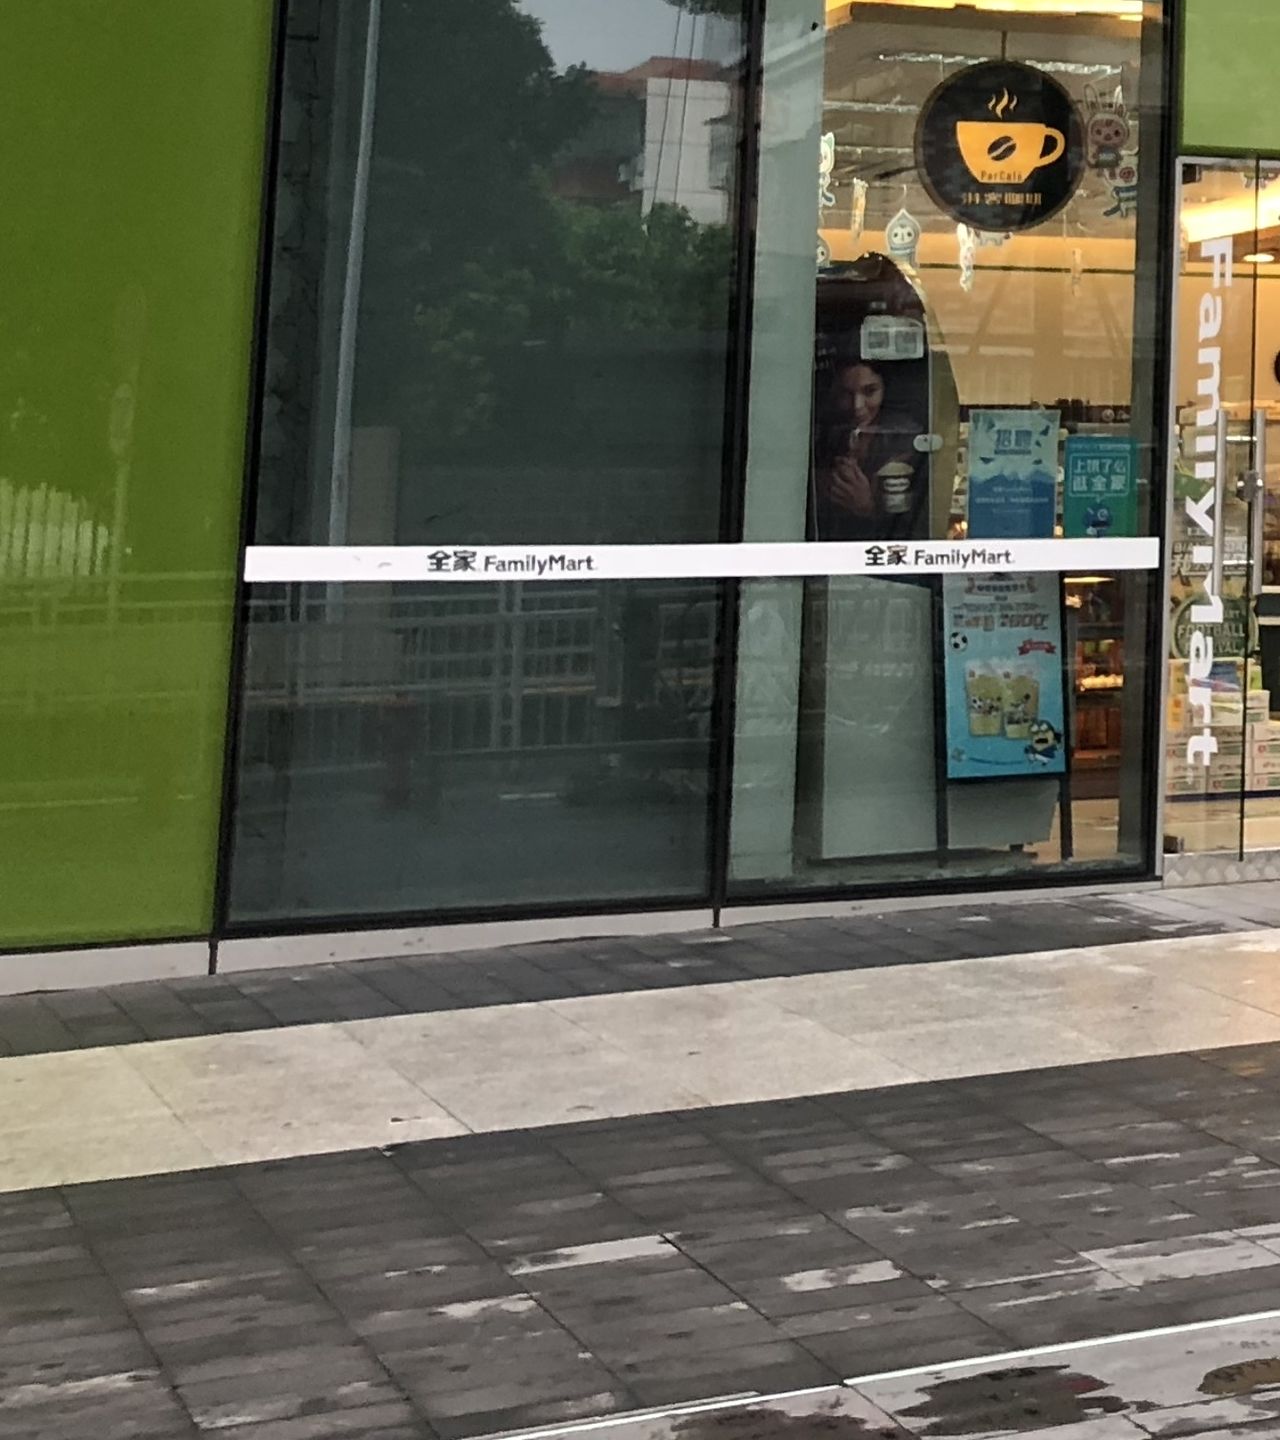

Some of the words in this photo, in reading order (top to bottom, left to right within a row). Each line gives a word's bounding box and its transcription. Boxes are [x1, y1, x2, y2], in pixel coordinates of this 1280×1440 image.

[427, 550, 477, 573] 全家
[484, 554, 594, 576] FamilyMart
[865, 544, 908, 566] 全家
[914, 548, 1011, 568] FamilyMart
